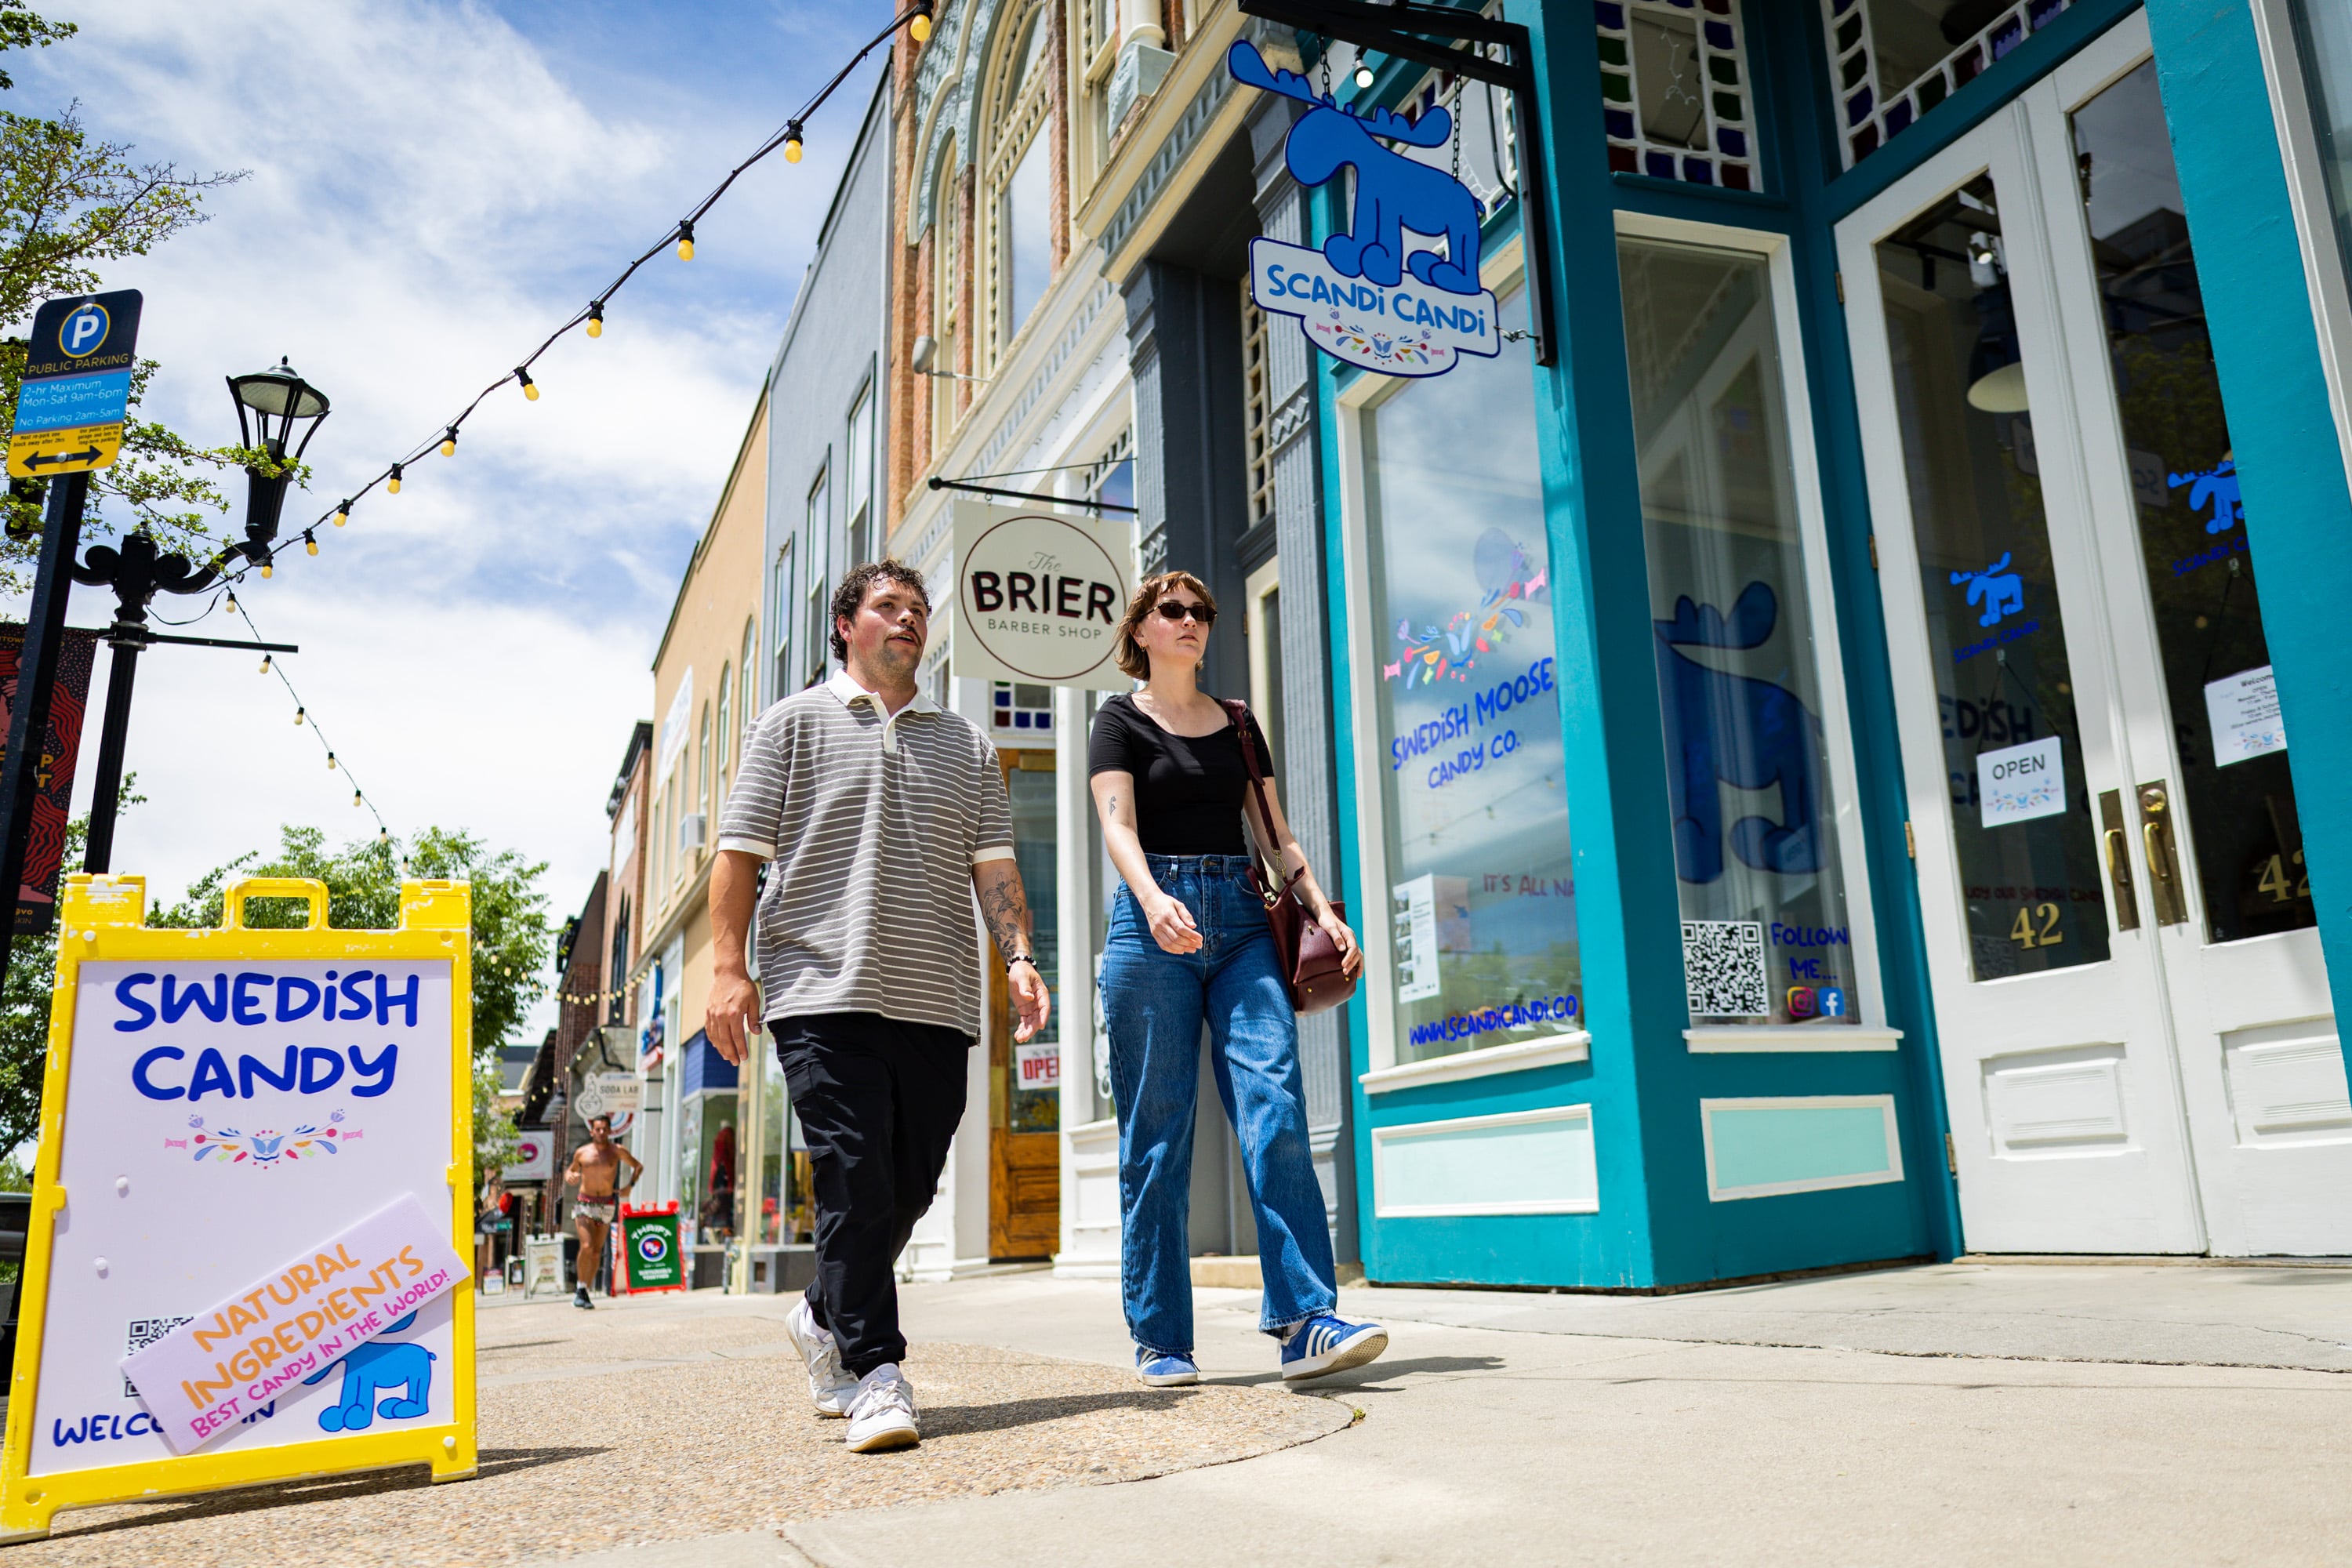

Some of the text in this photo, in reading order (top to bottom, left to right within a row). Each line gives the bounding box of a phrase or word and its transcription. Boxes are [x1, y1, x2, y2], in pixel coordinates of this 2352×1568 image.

[71, 315, 100, 349] P
[28, 354, 129, 375] PUBLIC PARKING
[23, 388, 122, 408] Mon-Sat 9am-6pm
[24, 380, 102, 397] 2-hr Maximum
[20, 408, 120, 427] No Parking 2am-5am
[1027, 551, 1062, 573] The
[971, 571, 1116, 625] BRIER
[988, 619, 1102, 640] BARBER SHOP
[1474, 657, 1553, 726] MOOSE
[2241, 674, 2274, 687] Welcom
[1428, 729, 1521, 789] CANDY CO.
[1992, 753, 2045, 780] OPEN
[1518, 874, 1548, 898] ALL
[1770, 922, 1849, 947] FOLLOW
[2009, 902, 2063, 950] 42
[131, 1044, 398, 1102] CANDY
[1022, 1056, 1060, 1080] OPE
[192, 1243, 361, 1353] NATURAL
[189, 1397, 241, 1439] BEST
[248, 1351, 317, 1401] CANDY
[318, 1335, 343, 1358] IN
[345, 1311, 383, 1341] THE
[383, 1269, 452, 1317] WORLD!
